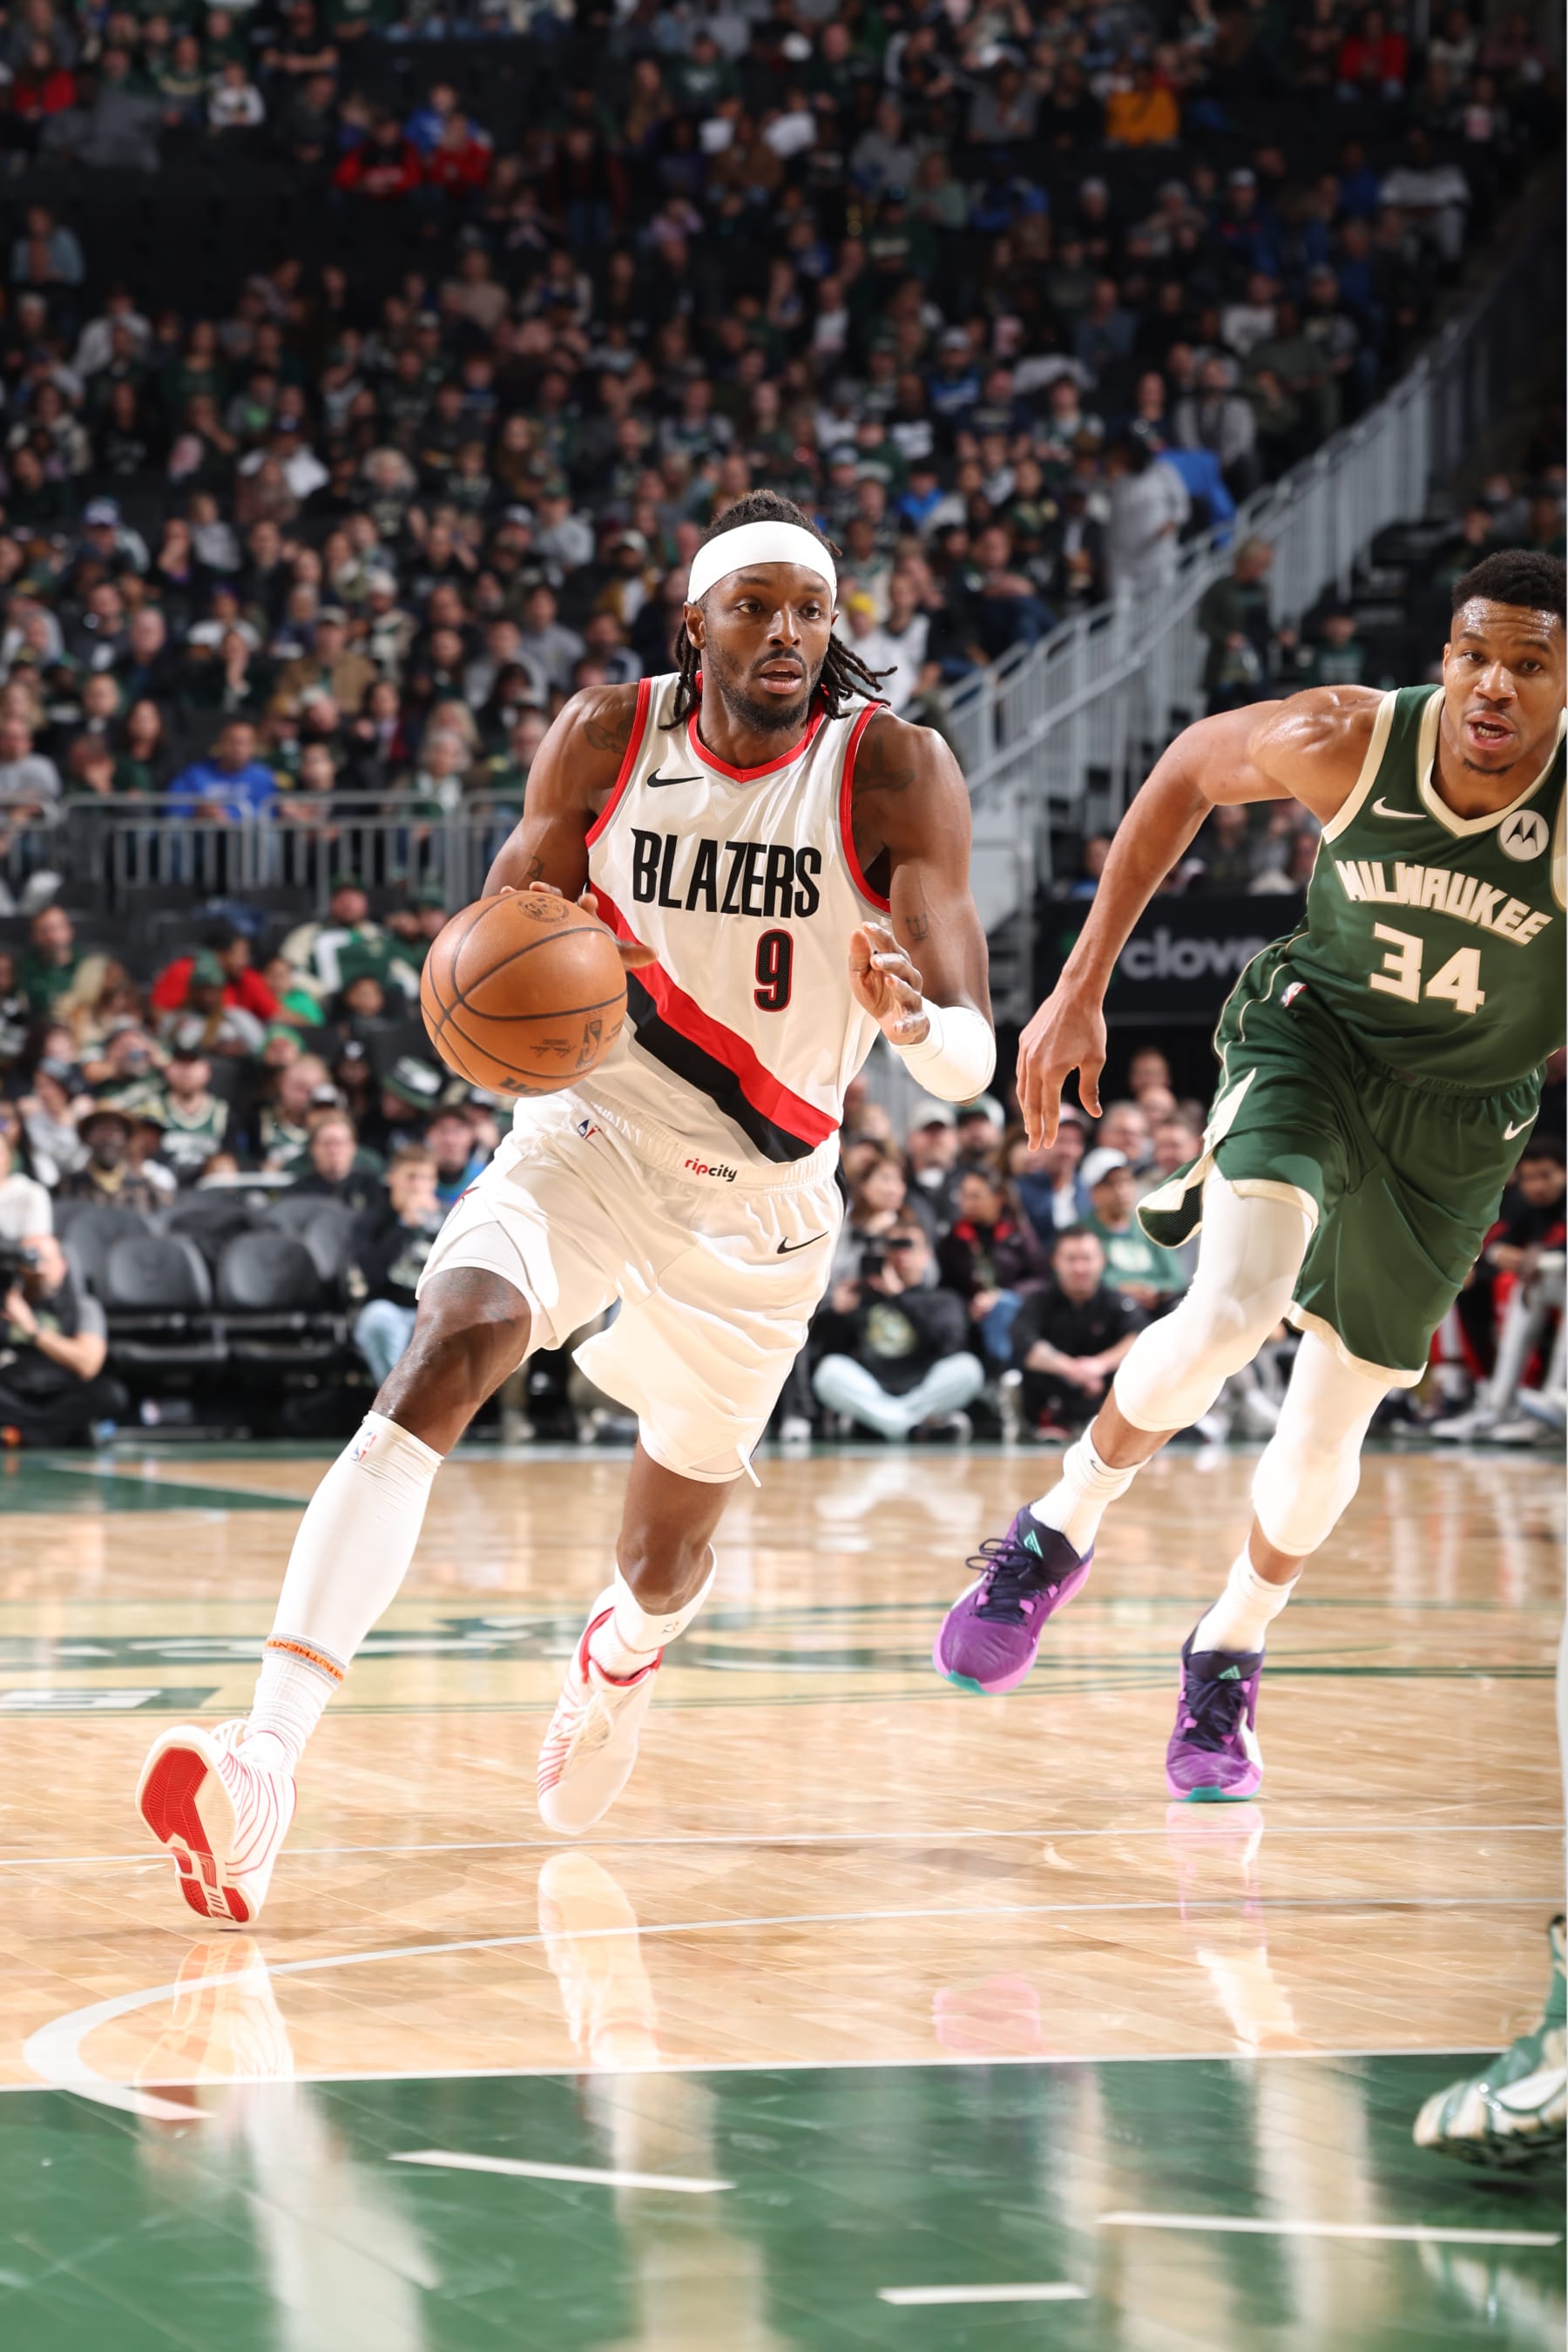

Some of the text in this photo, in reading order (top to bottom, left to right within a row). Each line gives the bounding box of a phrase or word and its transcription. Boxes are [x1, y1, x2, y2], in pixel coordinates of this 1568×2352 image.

[631, 828, 822, 919] BLAZERS
[1335, 860, 1554, 947] MILWAUKEE
[754, 929, 794, 1012] 9
[1369, 922, 1485, 1014] 34
[684, 1158, 738, 1182] ripcity
